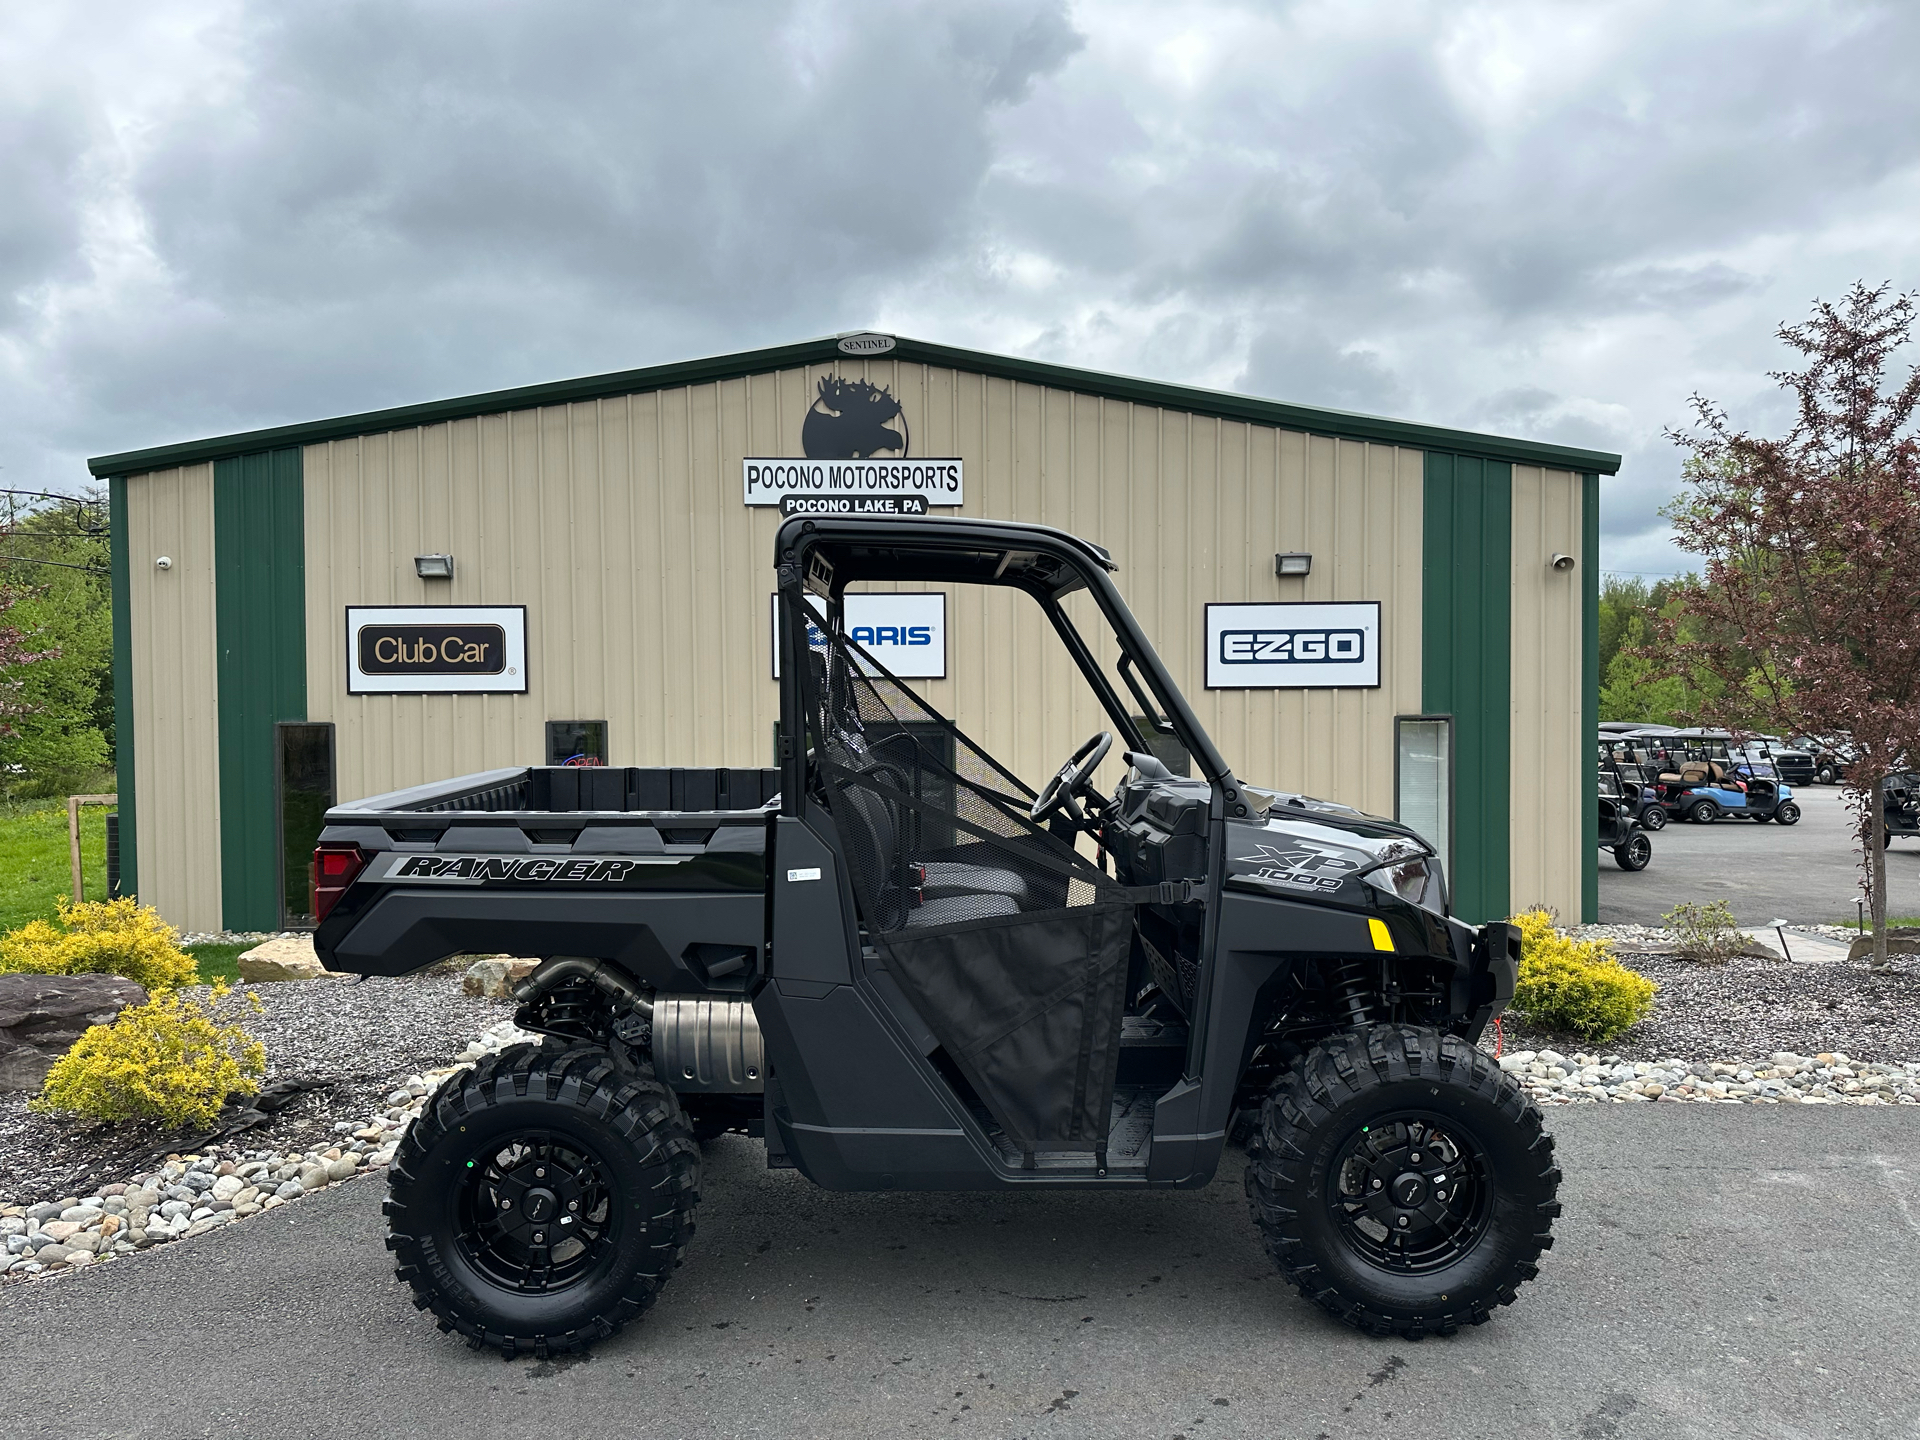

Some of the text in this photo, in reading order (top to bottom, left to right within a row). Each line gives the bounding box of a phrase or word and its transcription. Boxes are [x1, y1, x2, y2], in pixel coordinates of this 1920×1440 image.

[844, 339, 890, 351] SENTINEL
[748, 465, 958, 494] POCONO MOTORSPORTS
[786, 500, 922, 514] POCONO LAKE, PA
[374, 636, 489, 664] Club Car
[1223, 632, 1361, 661] EZGO
[396, 855, 635, 882] RANGER
[1234, 844, 1361, 872] XP
[1257, 867, 1344, 889] 1000
